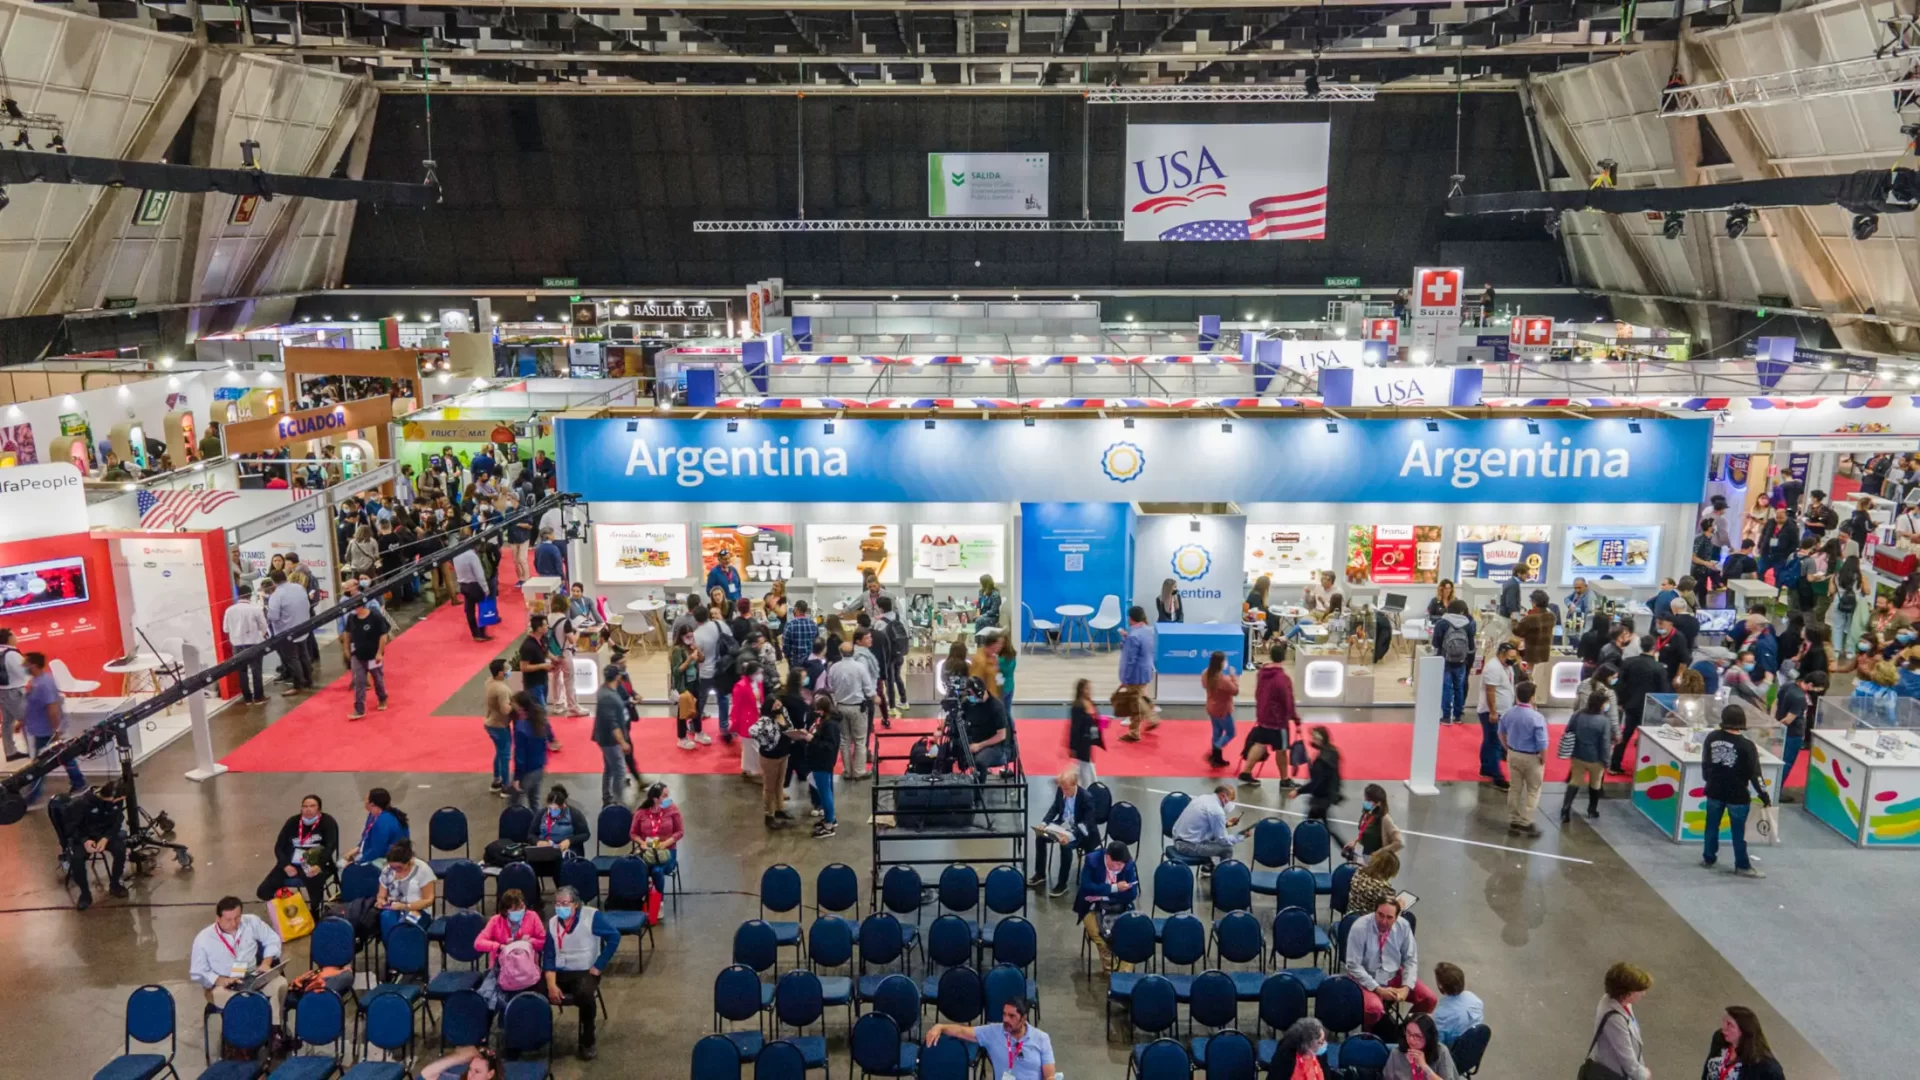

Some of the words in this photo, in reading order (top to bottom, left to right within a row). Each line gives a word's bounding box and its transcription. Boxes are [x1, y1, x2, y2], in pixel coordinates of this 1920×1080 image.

[971, 172, 1001, 180] SALIDA
[1132, 145, 1228, 194] USA
[634, 304, 687, 317] BASILUR
[688, 305, 713, 317] TEA
[1420, 308, 1457, 316] Suiza.
[1300, 349, 1340, 371] USA
[1375, 378, 1424, 404] USA
[279, 411, 345, 439] ECUADOR
[431, 429, 457, 437] FRUCT
[625, 436, 848, 487] Argentina
[1400, 436, 1630, 487] Argentina
[1486, 549, 1518, 560] BONALMA
